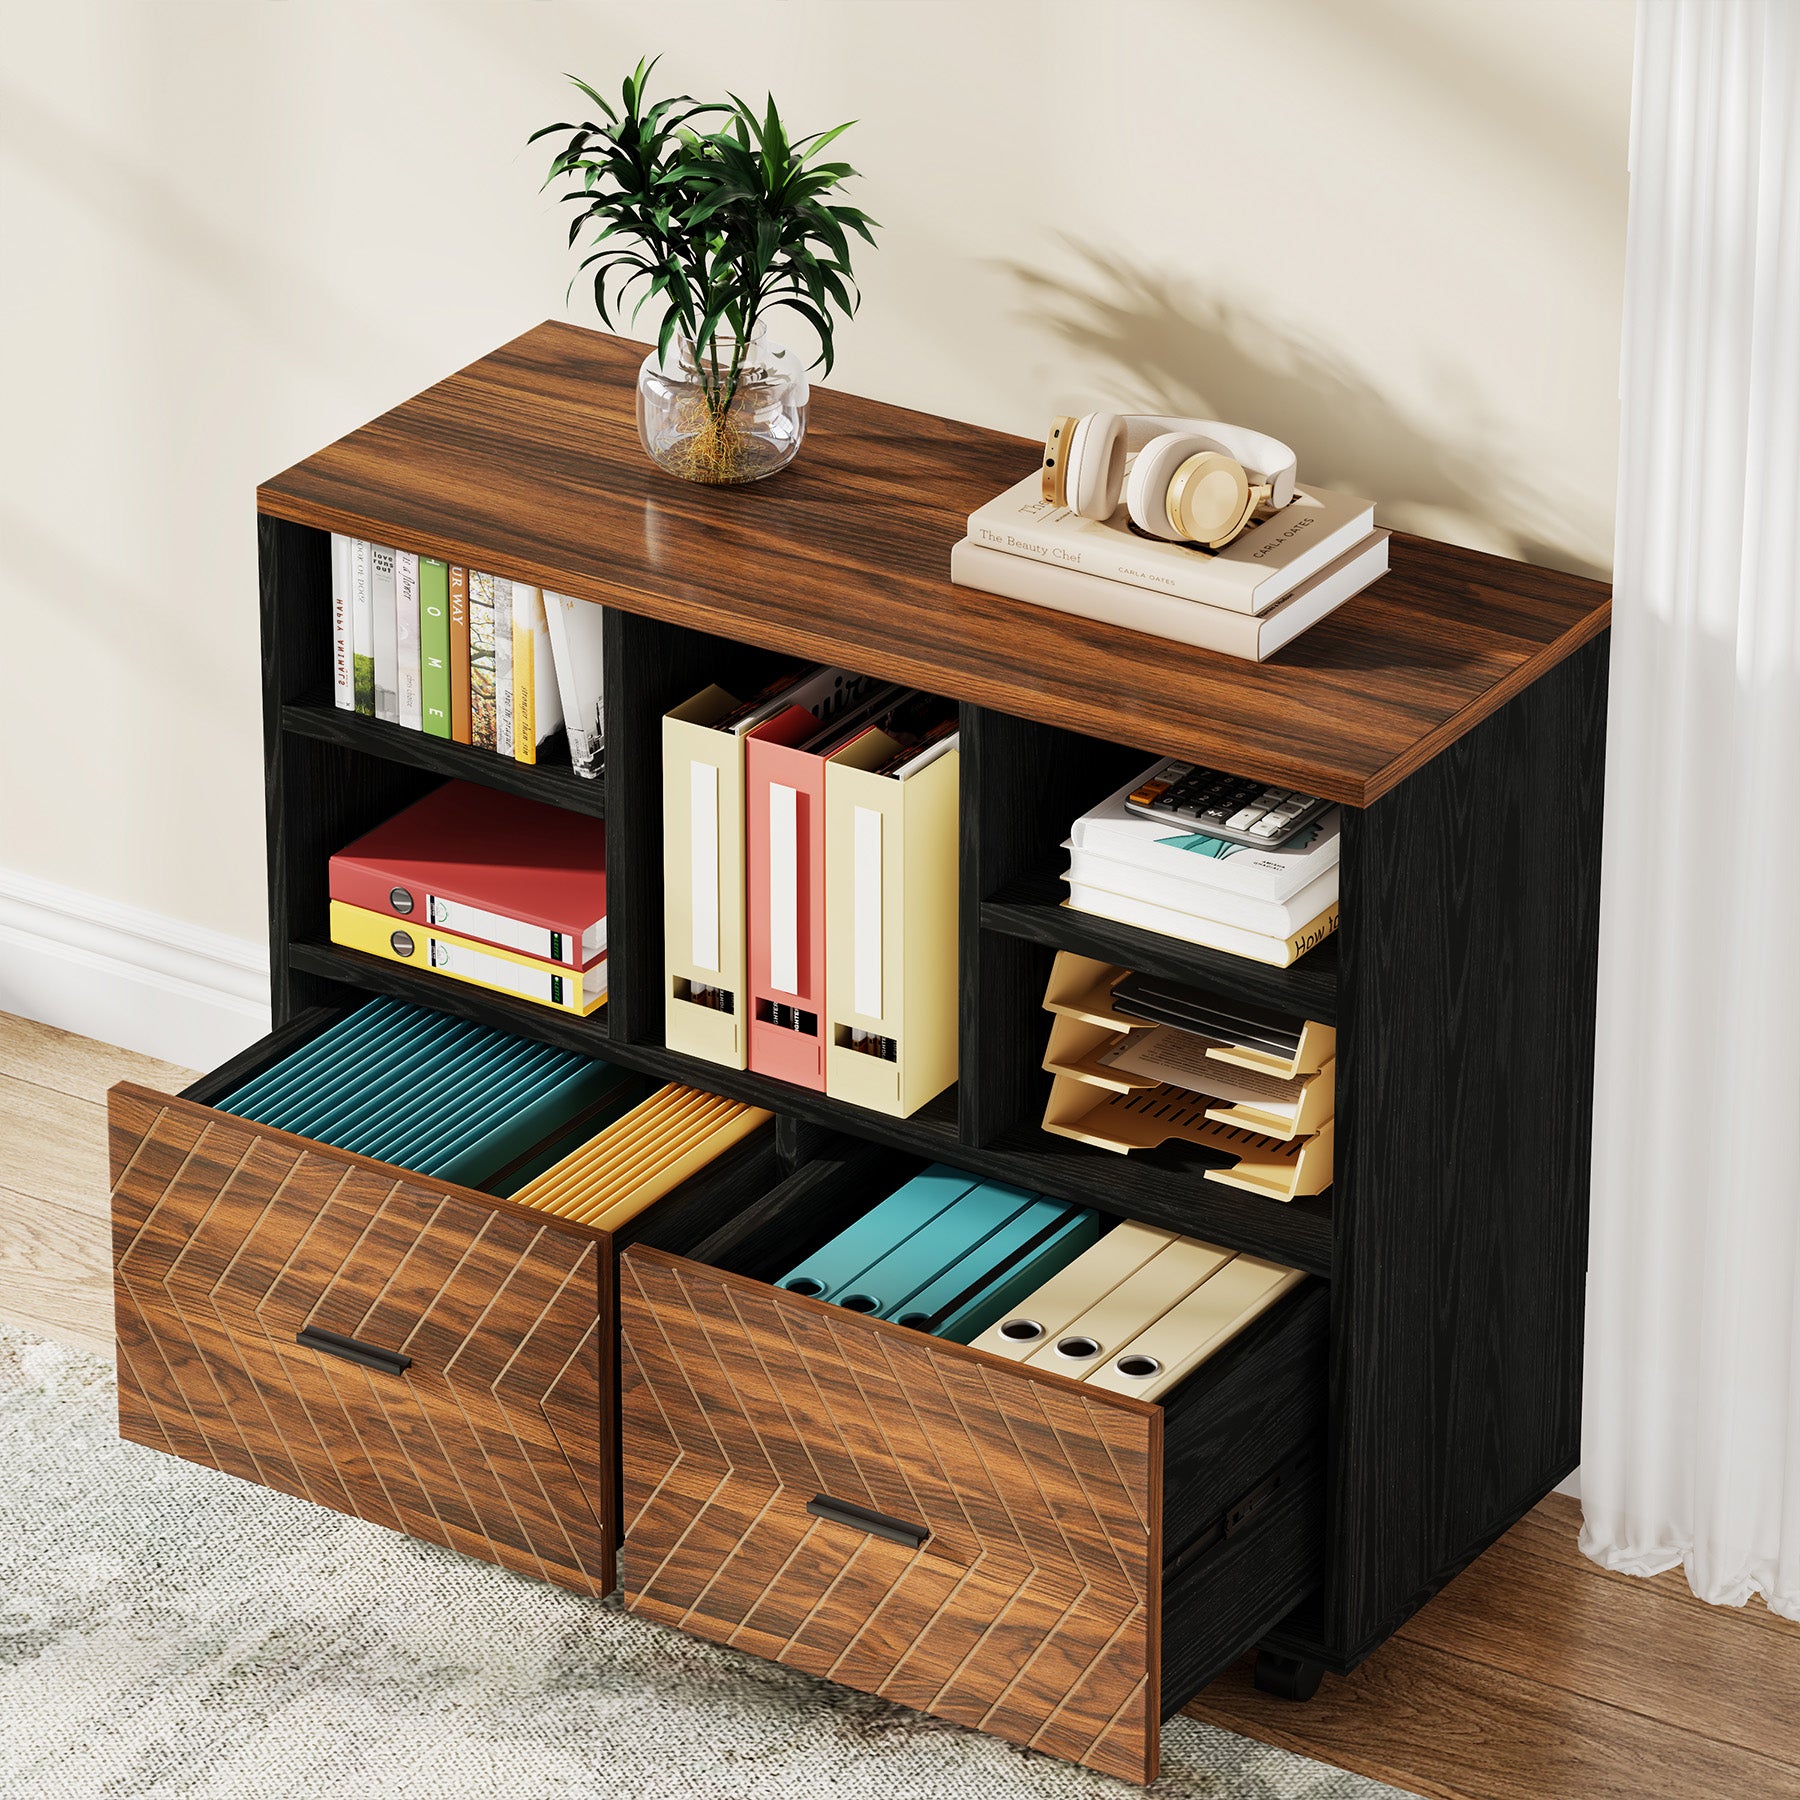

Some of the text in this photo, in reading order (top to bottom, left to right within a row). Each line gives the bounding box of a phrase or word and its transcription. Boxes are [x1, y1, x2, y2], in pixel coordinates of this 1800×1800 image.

[979, 528, 1081, 563] The Beauty Chef
[1253, 516, 1315, 559] CARLA OATES
[373, 551, 393, 562] love
[373, 558, 394, 568] runs
[376, 565, 391, 573] out
[1118, 566, 1176, 586] CARLA OATES
[452, 594, 464, 626] WAY
[504, 689, 513, 707] love
[519, 685, 529, 719] stronger
[522, 721, 531, 741] than
[1294, 926, 1325, 958] How
